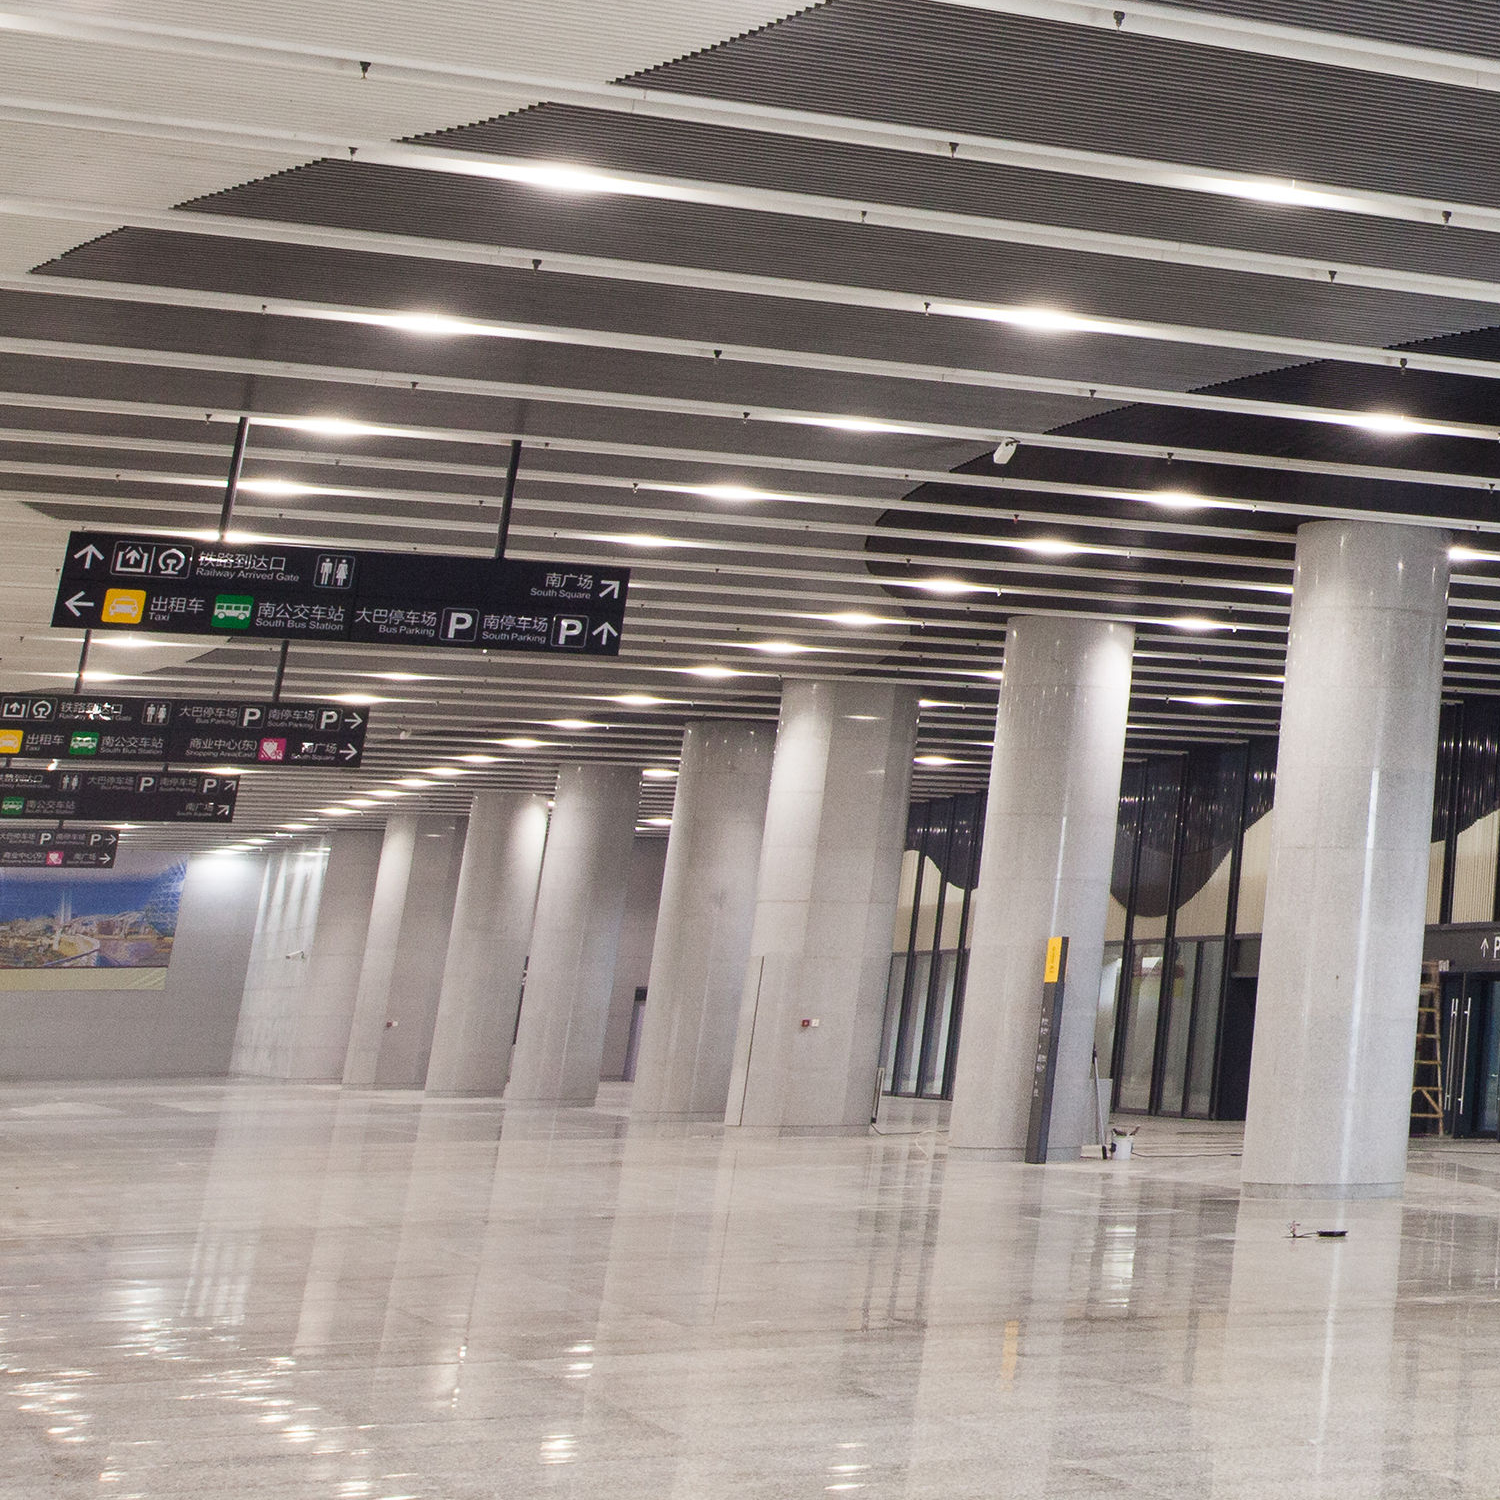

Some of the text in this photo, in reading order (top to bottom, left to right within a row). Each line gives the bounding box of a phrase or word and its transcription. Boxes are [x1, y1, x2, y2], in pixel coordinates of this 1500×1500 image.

[196, 568, 299, 583] Railway Arrived Gate
[545, 572, 593, 589] 南广场
[530, 587, 591, 600] South Square
[150, 596, 205, 614] 出租车
[258, 602, 345, 621] 南公交车站
[149, 612, 170, 622] Taxi
[255, 617, 344, 631] South Bus Station
[355, 607, 437, 627] 大巴停车场
[483, 614, 549, 632] 南停车场
[379, 624, 435, 637] Bus Parking
[448, 612, 473, 638] P
[558, 618, 582, 645] P
[482, 631, 546, 644] South Parking
[242, 708, 261, 727] P
[320, 711, 338, 730] P
[140, 777, 154, 792] P
[203, 778, 217, 793] P
[40, 833, 52, 845] P
[90, 834, 102, 846] P
